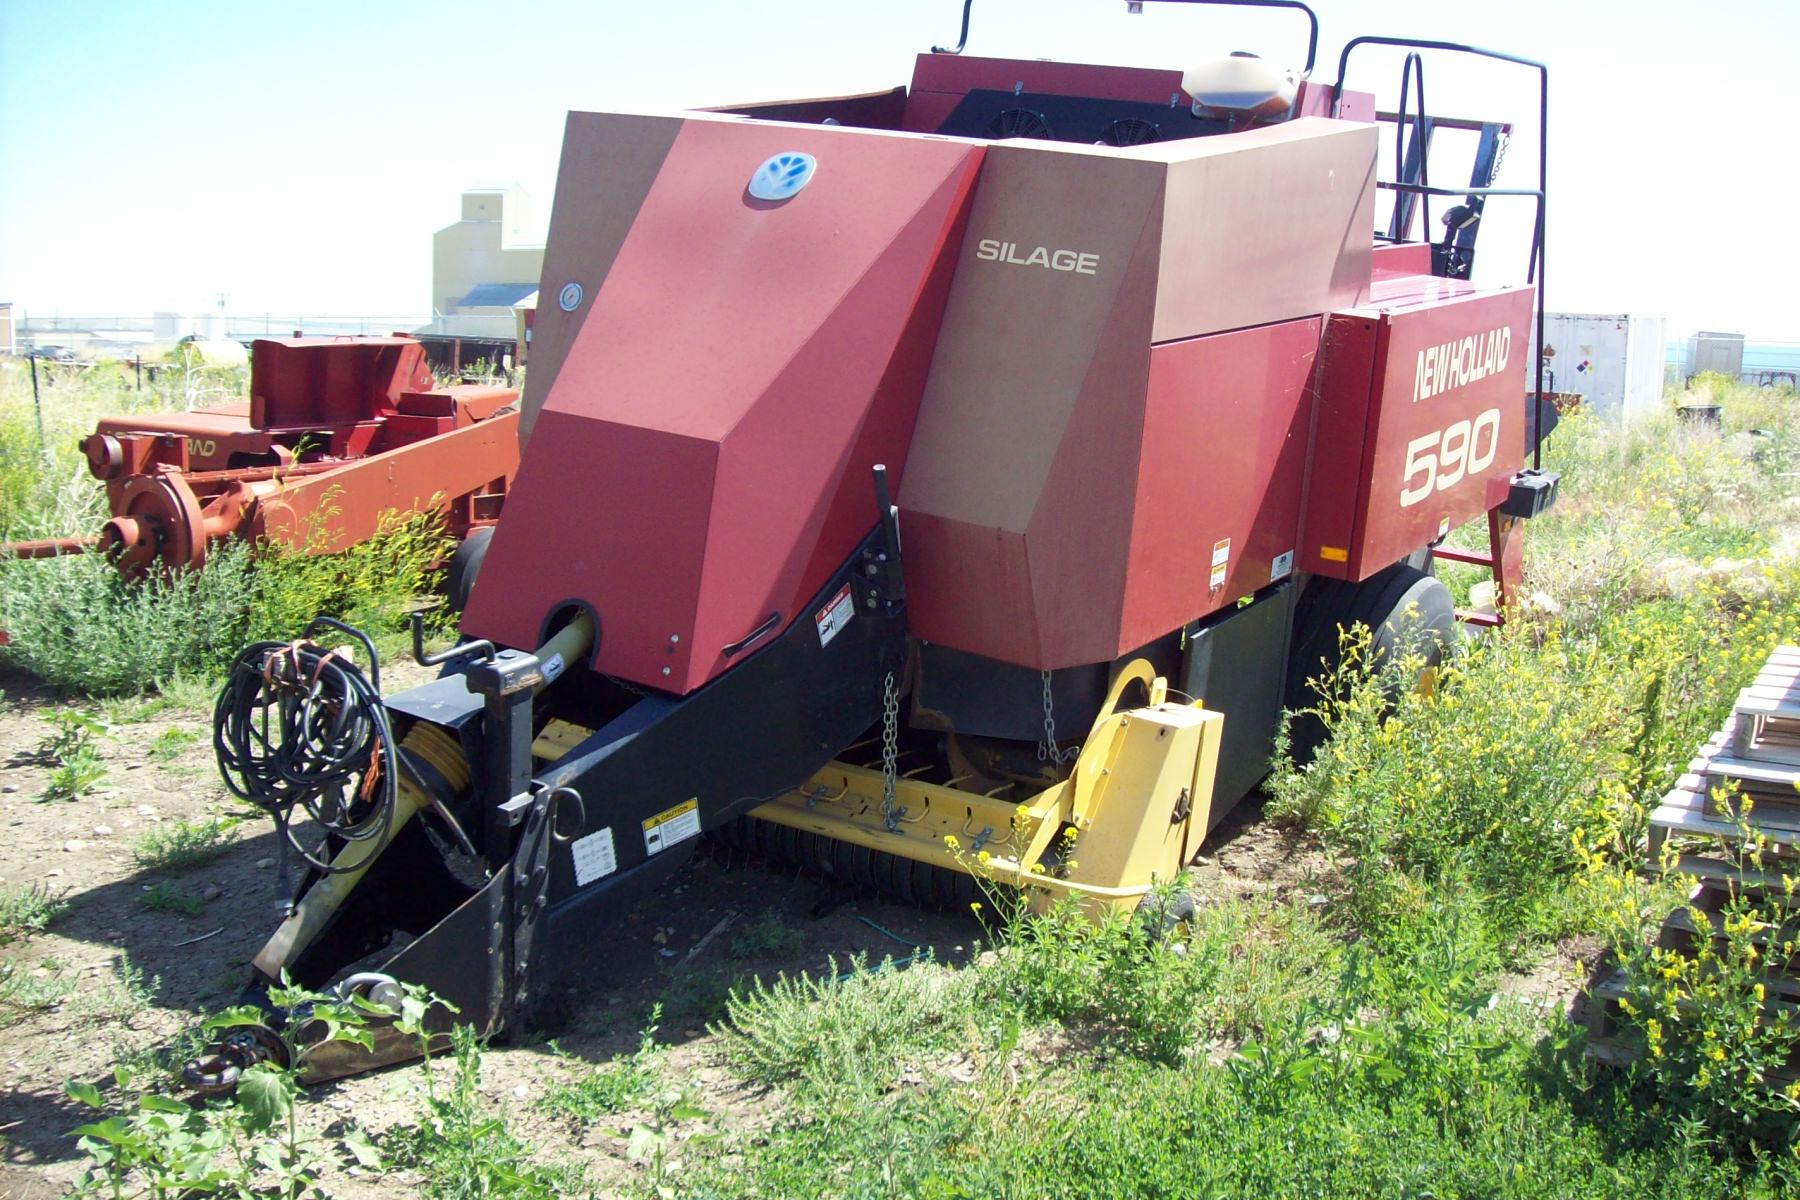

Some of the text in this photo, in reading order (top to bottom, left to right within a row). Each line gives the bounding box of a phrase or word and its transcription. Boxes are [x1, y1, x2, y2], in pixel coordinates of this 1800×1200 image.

[976, 239, 1100, 275] SILAGE
[1413, 326, 1511, 403] NEW HOLLAND
[1400, 408, 1500, 507] 590
[661, 805, 689, 821] CAUTION
